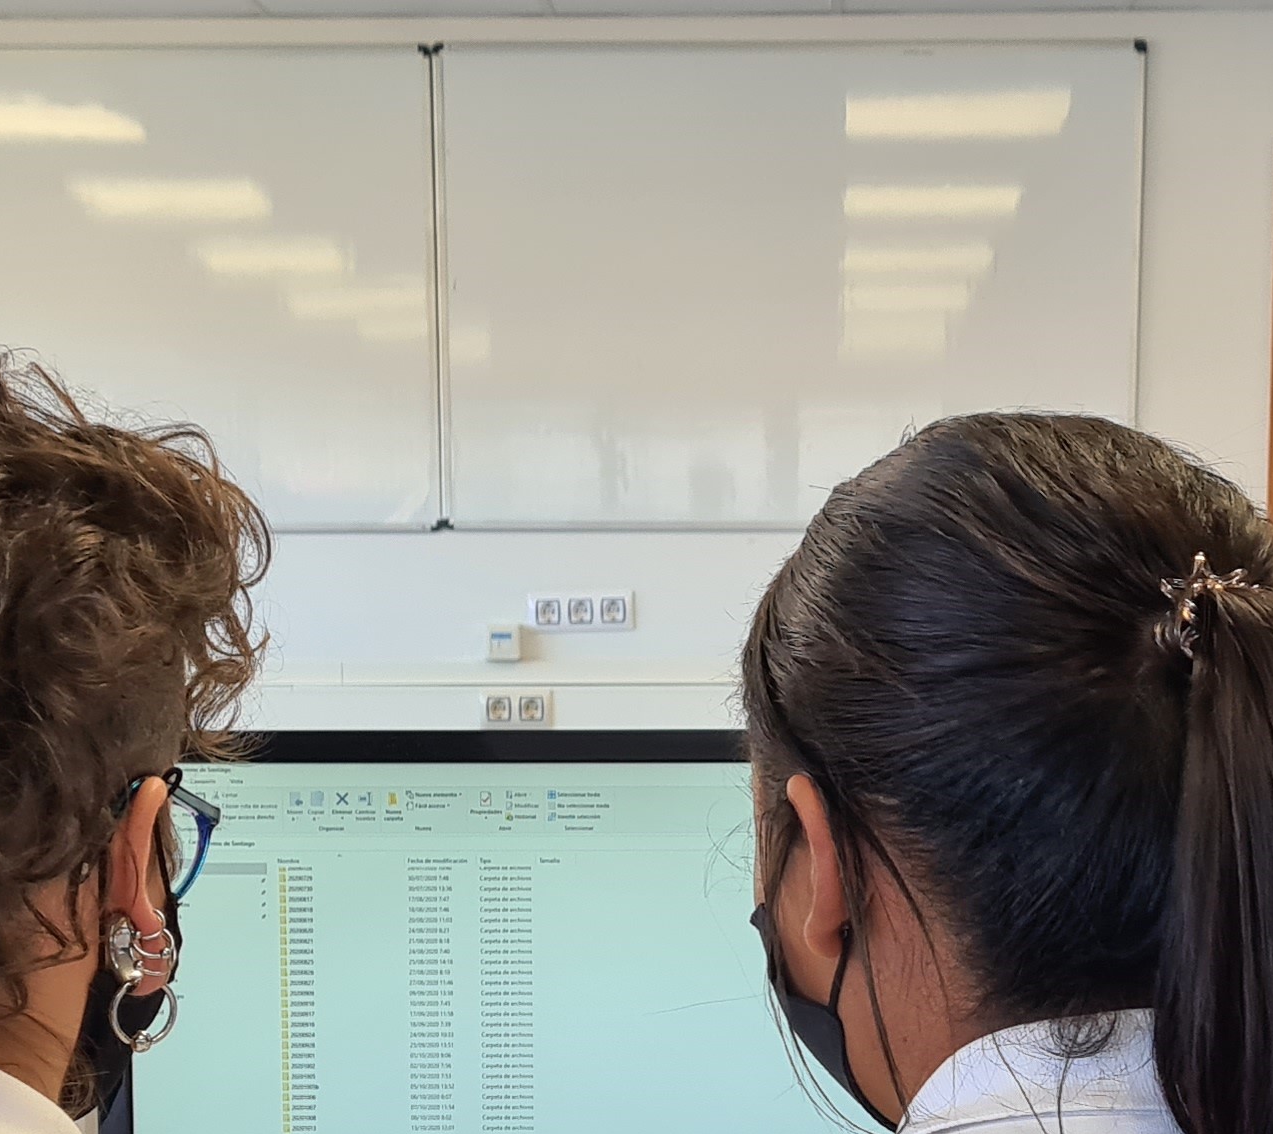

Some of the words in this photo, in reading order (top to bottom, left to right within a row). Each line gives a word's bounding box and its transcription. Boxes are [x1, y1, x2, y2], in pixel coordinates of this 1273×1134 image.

[479, 885, 500, 893] Carpeta
[479, 895, 500, 903] Carpeta
[480, 906, 500, 914] Carpeta
[480, 916, 501, 924] Carpeta
[480, 927, 501, 935] Carpeta
[480, 937, 501, 945] Carpeta
[480, 958, 501, 966] Carpeta
[480, 968, 501, 976] Carpeta
[480, 979, 501, 987] Carpeta
[480, 989, 501, 997] Carpeta
[481, 1010, 501, 1018] Carpeta
[481, 1020, 502, 1028] Carpeta
[481, 1031, 502, 1039] Carpeta
[481, 1041, 502, 1049] Carpeta
[481, 1051, 502, 1059] Carpeta
[481, 1062, 502, 1070] Carpeta
[481, 1072, 502, 1080] Carpeta
[482, 1093, 502, 1101] Carpeta
[482, 1103, 502, 1111] Carpeta
[482, 1124, 503, 1132] Carpeta
